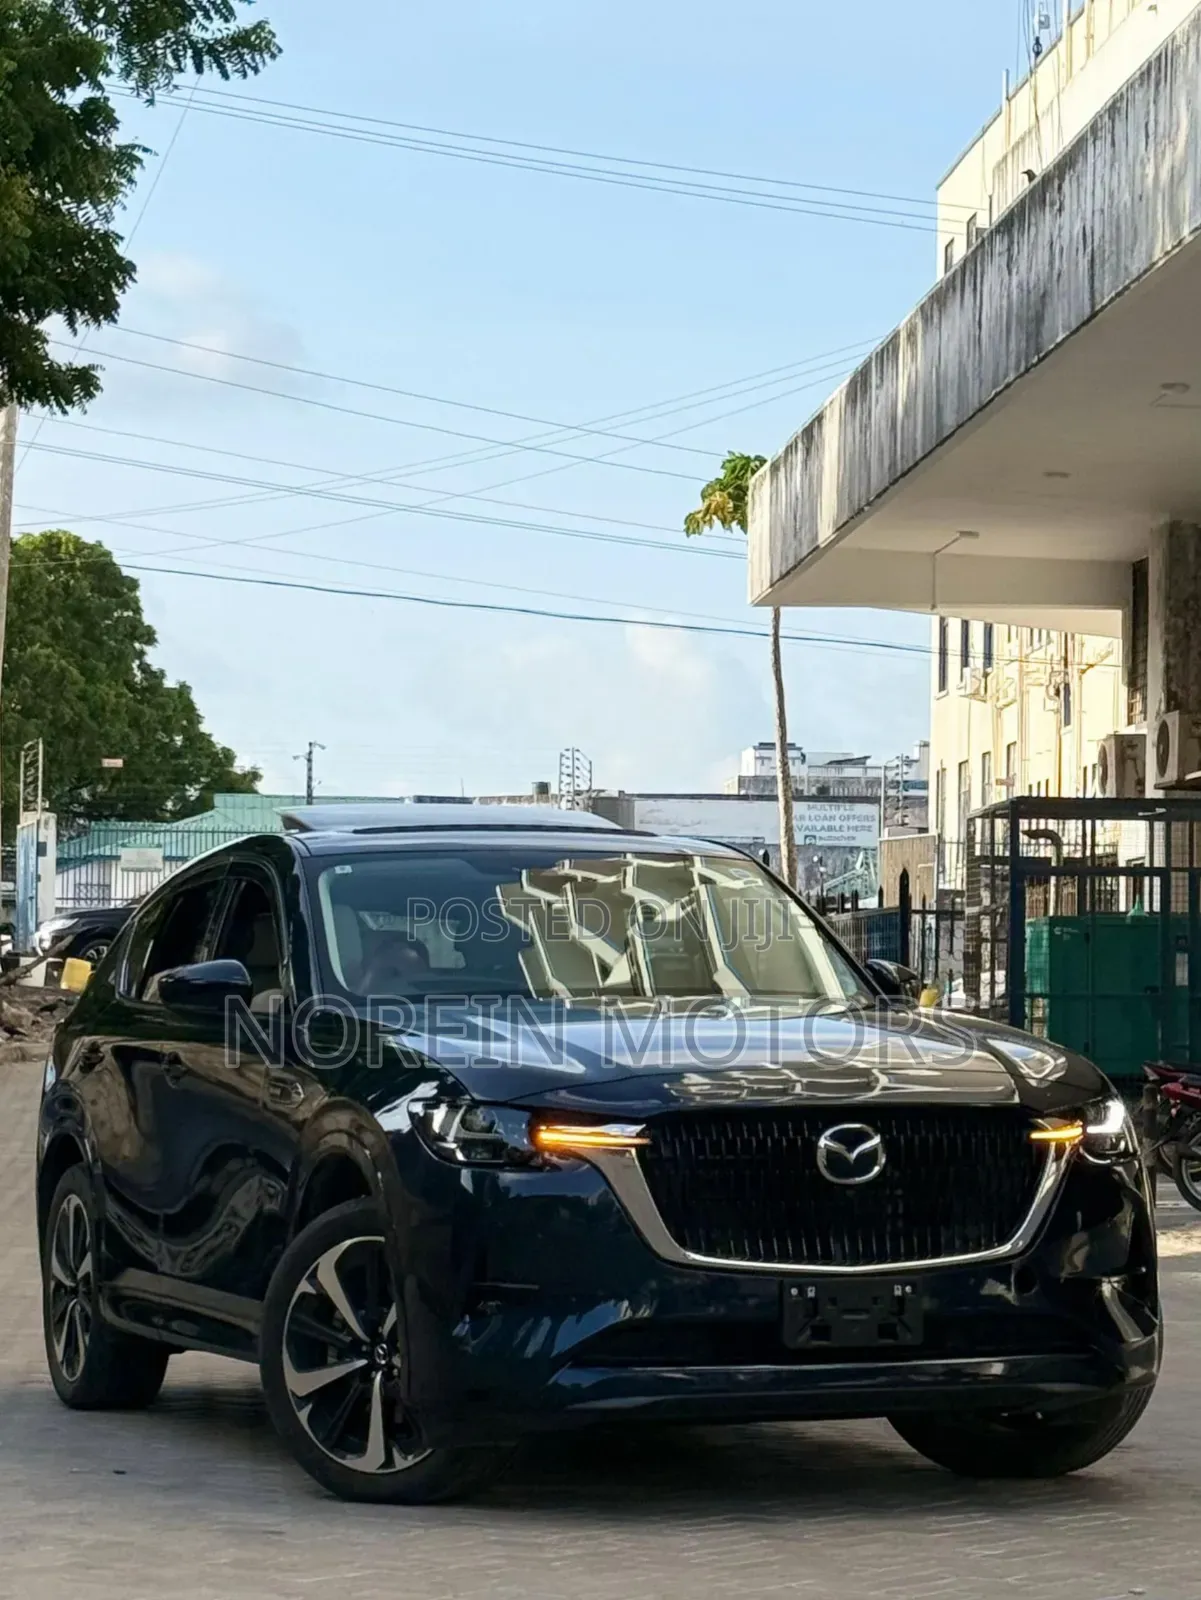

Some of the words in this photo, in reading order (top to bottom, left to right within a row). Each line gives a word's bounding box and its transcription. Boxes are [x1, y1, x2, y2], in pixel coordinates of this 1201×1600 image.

[838, 814, 876, 822] OFFERS
[794, 824, 845, 832] VAILABLE
[847, 824, 873, 832] HERE
